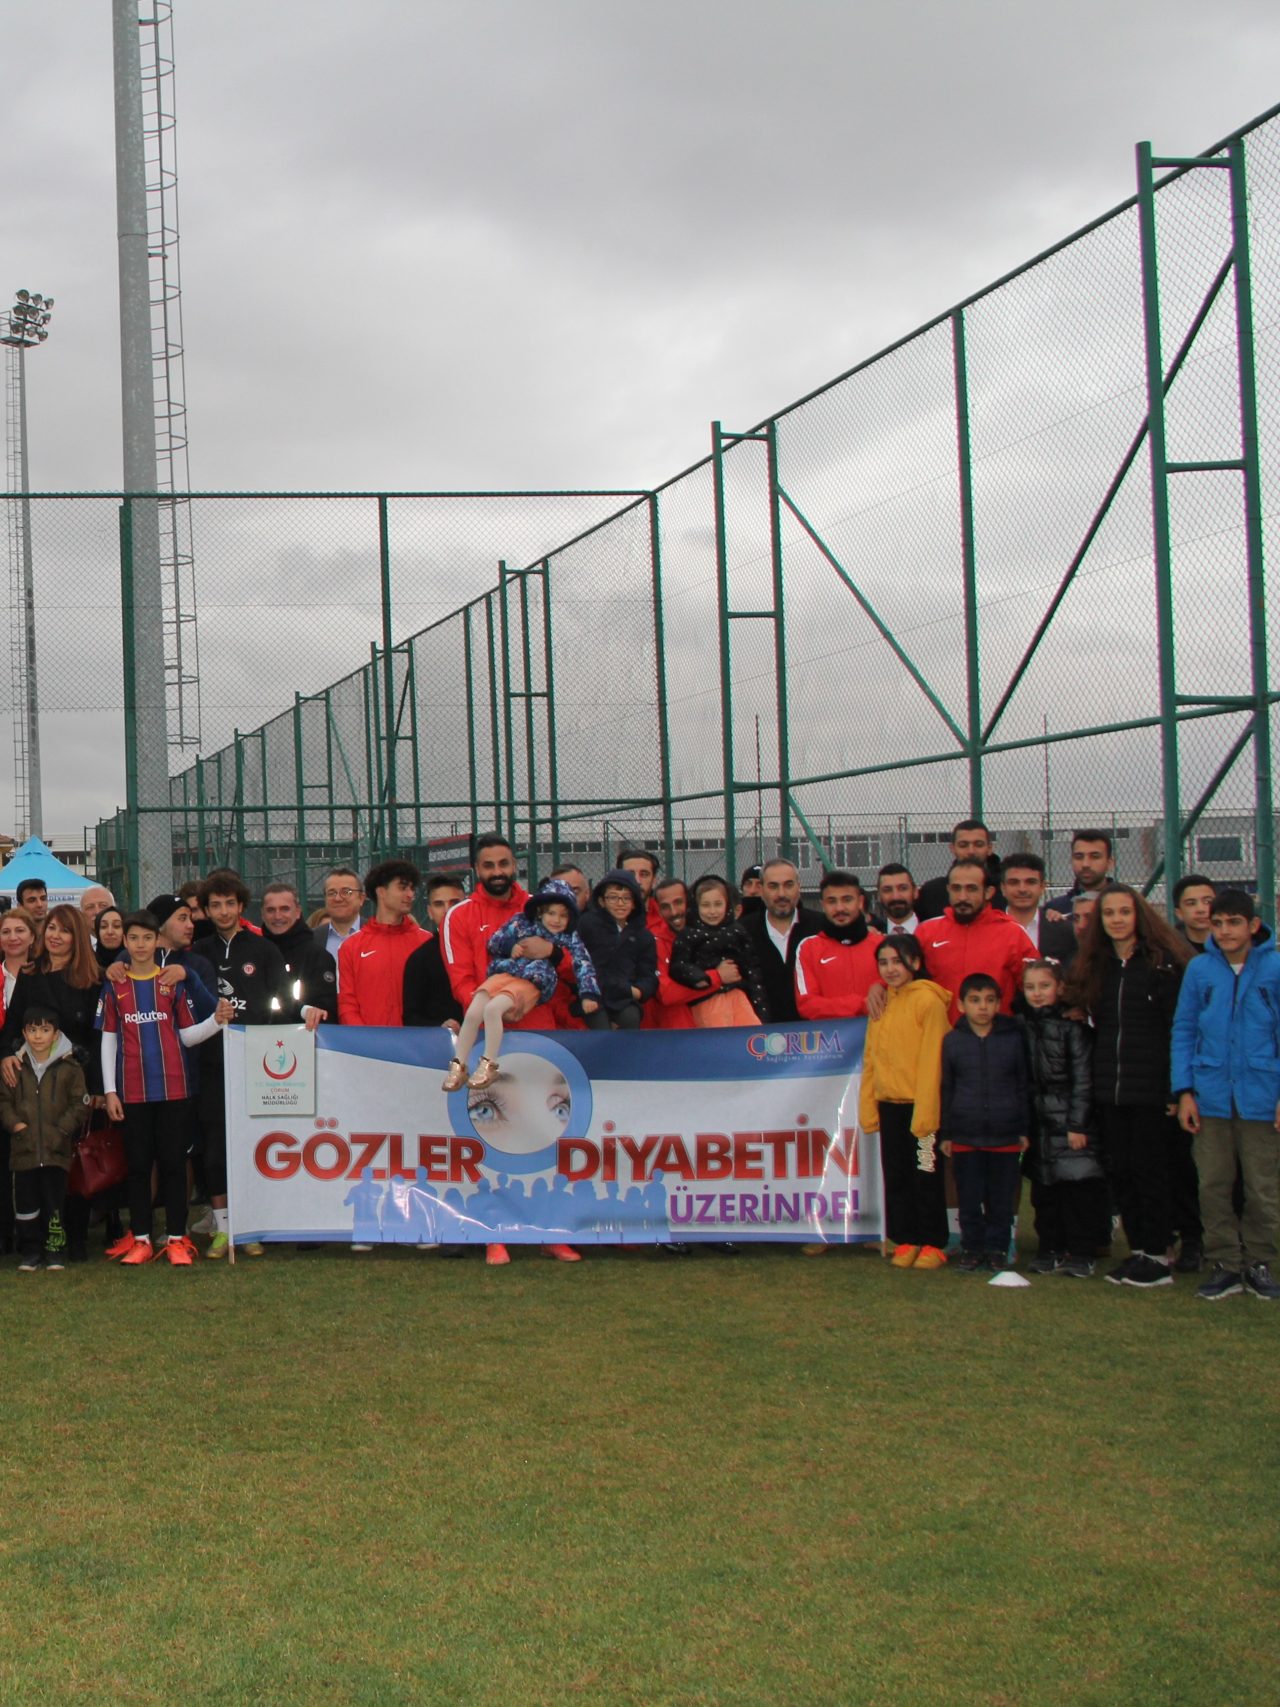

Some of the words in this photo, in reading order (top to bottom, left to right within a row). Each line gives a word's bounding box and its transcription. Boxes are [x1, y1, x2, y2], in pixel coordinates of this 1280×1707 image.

[124, 1010, 168, 1024] Rakuten
[746, 1030, 845, 1061] ÇORUM
[253, 1116, 486, 1183] GÖZLER
[556, 1112, 861, 1183] DİYABETİN
[669, 1184, 861, 1224] ÜZERİNDE!
